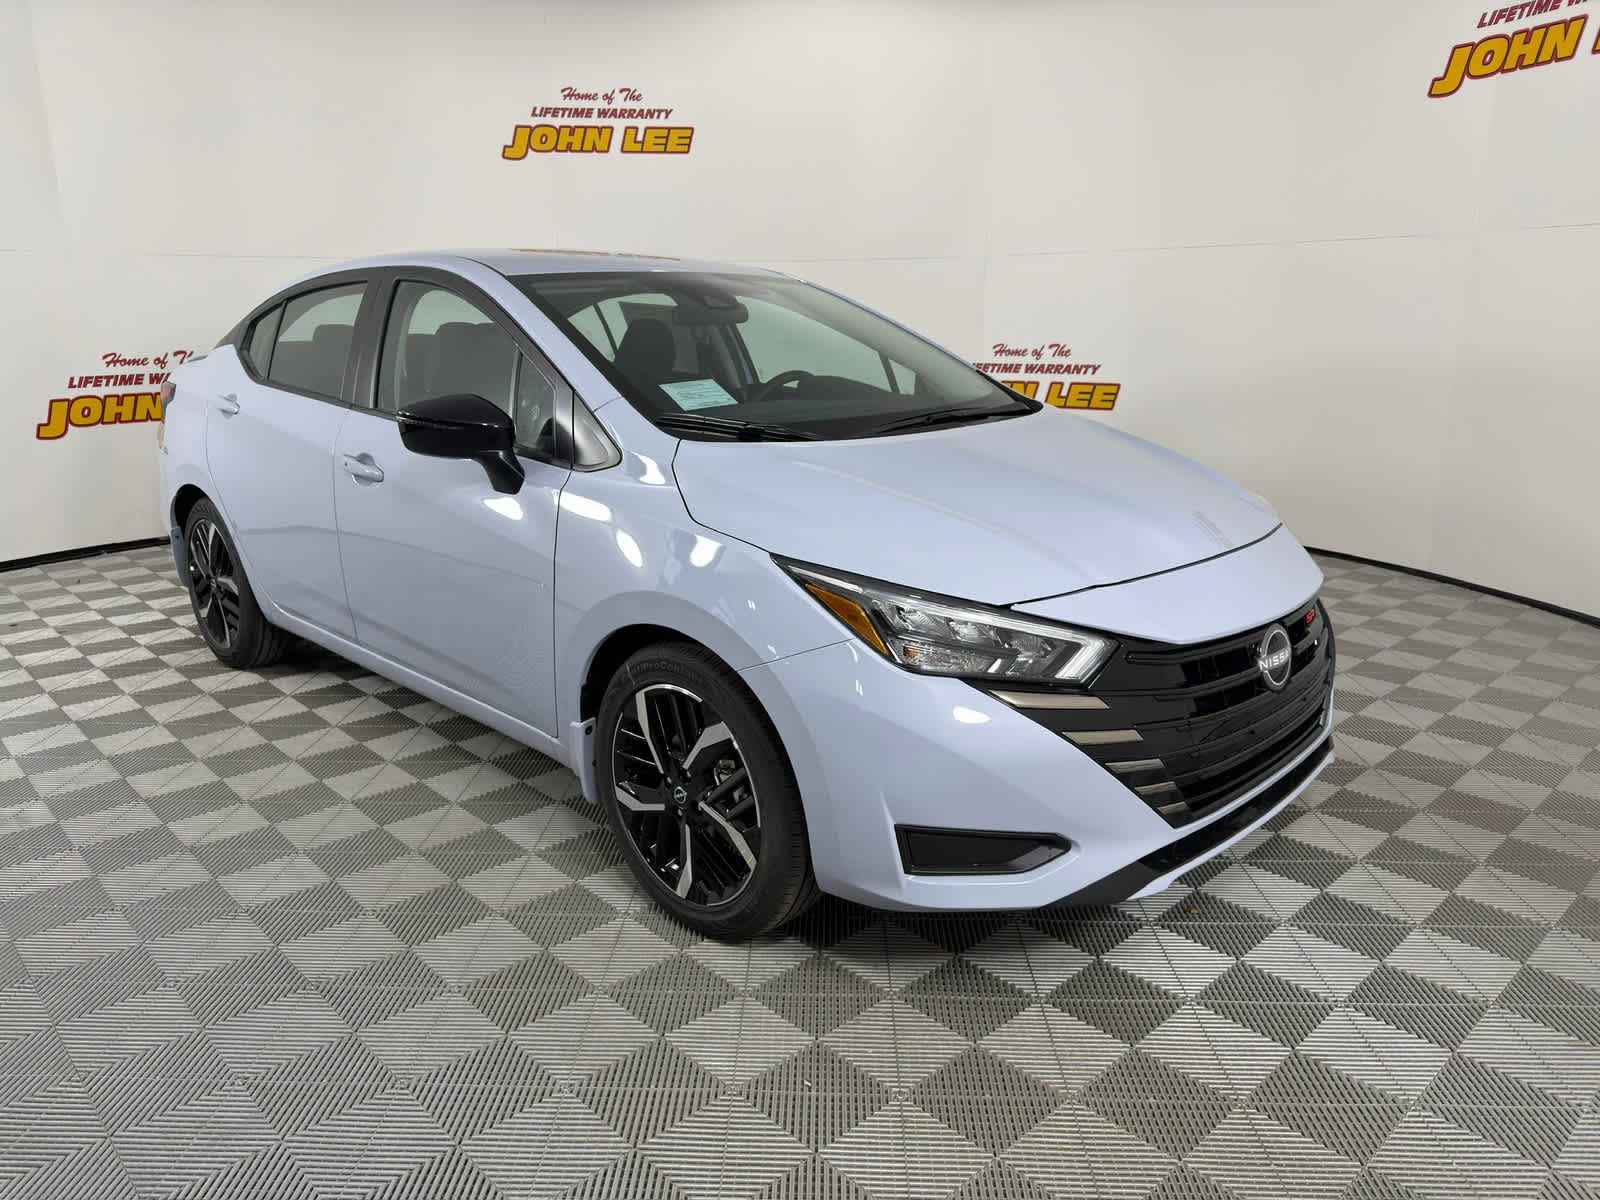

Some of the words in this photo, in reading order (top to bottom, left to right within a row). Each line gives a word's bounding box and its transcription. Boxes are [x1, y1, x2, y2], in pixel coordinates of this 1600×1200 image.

[1477, 0, 1561, 28] LIFETIME
[1427, 14, 1589, 98] JOHN
[561, 87, 599, 101] Home
[602, 88, 616, 104] of
[619, 87, 643, 102] The
[531, 106, 594, 119] LIFETIME
[597, 108, 673, 120] WARRANTY
[502, 124, 614, 160] JOHN
[620, 126, 694, 154] LEE
[102, 352, 150, 368] Home
[153, 352, 169, 370] of
[992, 343, 1029, 357] Home
[1031, 344, 1046, 360] of
[1048, 343, 1072, 358] The
[973, 362, 1021, 374] FETIME
[1024, 362, 1102, 375] WARRANTY
[68, 373, 145, 389] LIFETIME
[1045, 381, 1121, 411] LEE
[37, 392, 164, 440] JOHN
[1259, 649, 1290, 672] NISS
